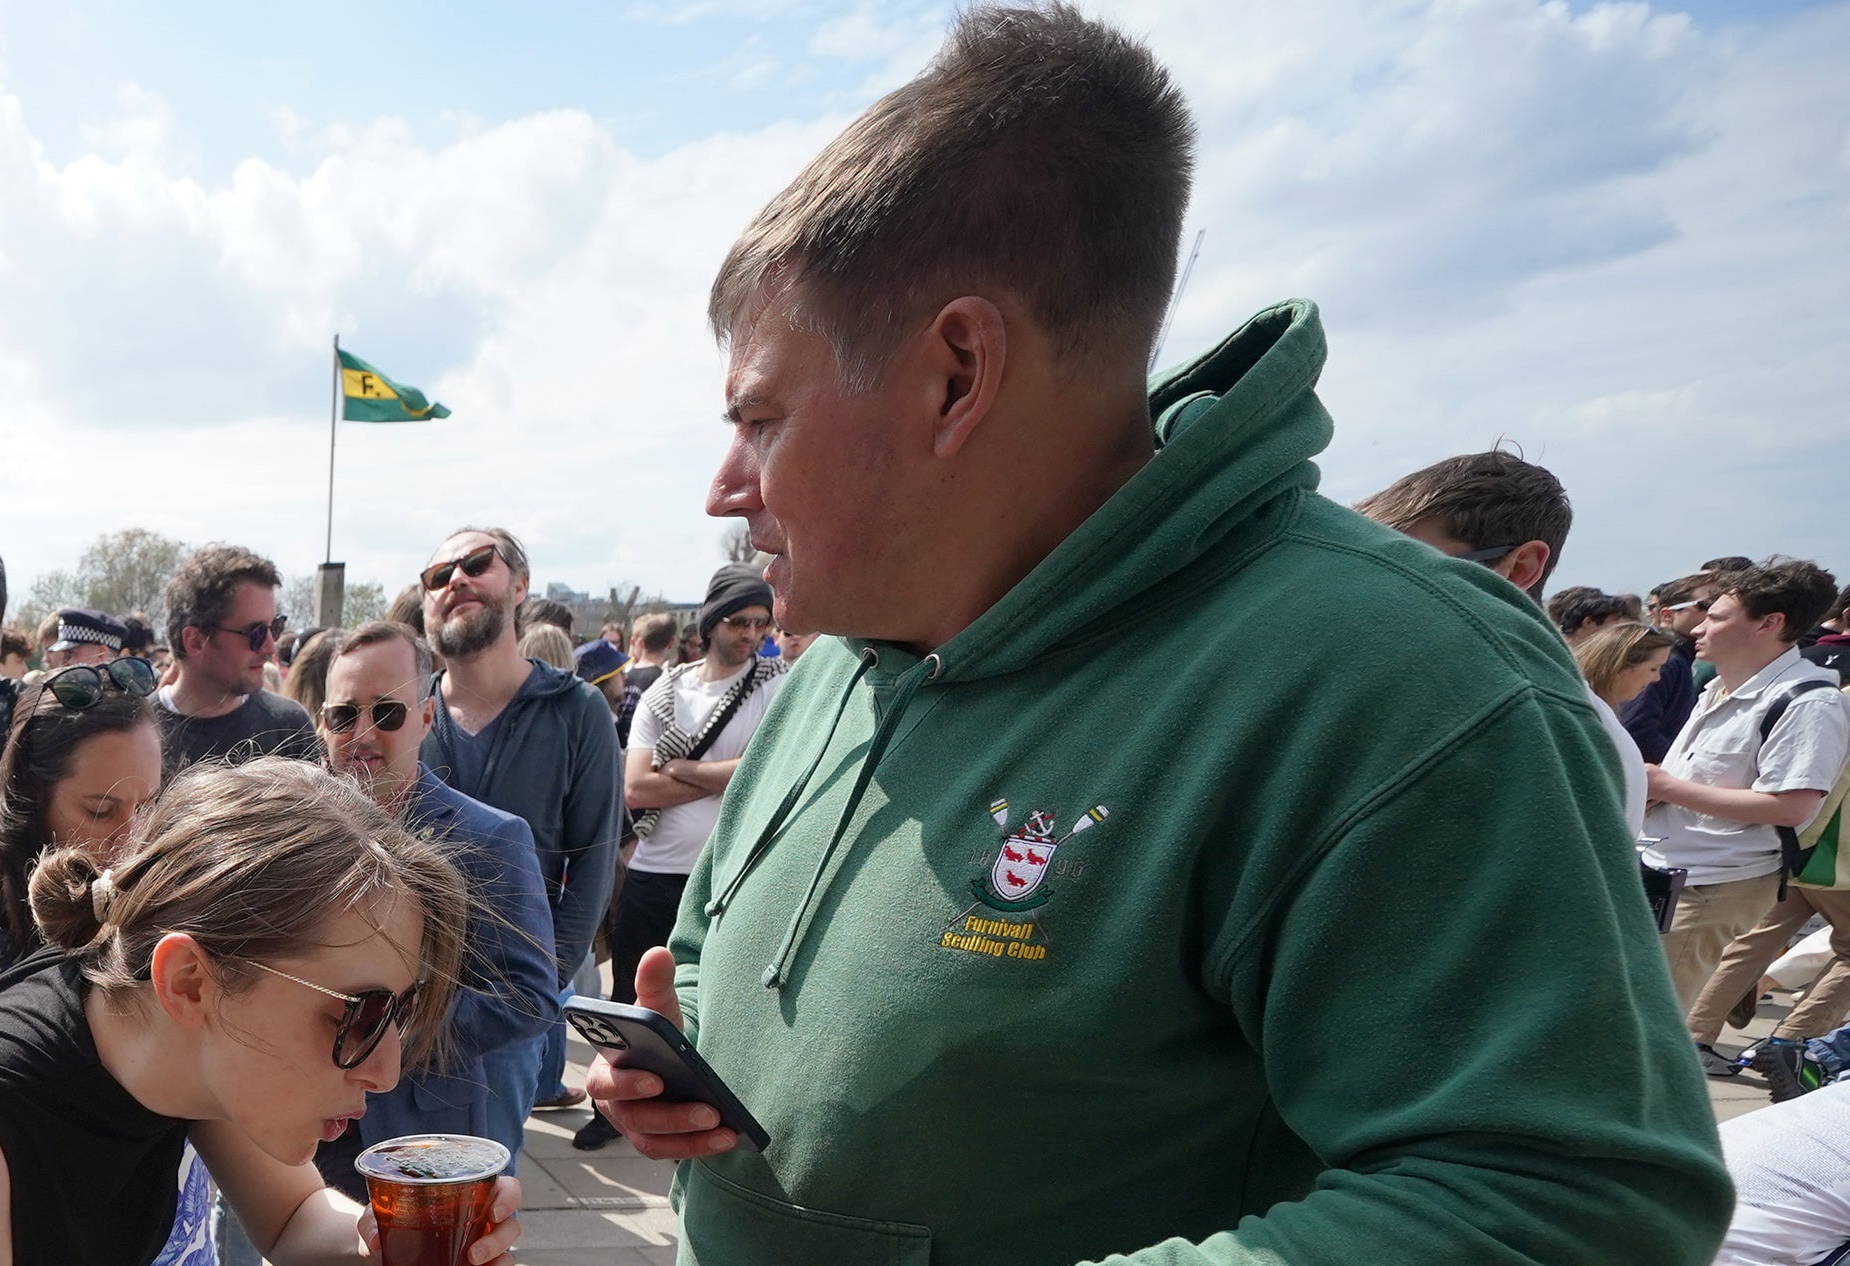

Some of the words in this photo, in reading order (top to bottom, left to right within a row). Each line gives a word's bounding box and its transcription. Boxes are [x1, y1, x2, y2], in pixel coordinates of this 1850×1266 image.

[964, 916, 1034, 940] Furnivall
[941, 932, 1006, 958] Sculling
[1007, 941, 1047, 960] Club
